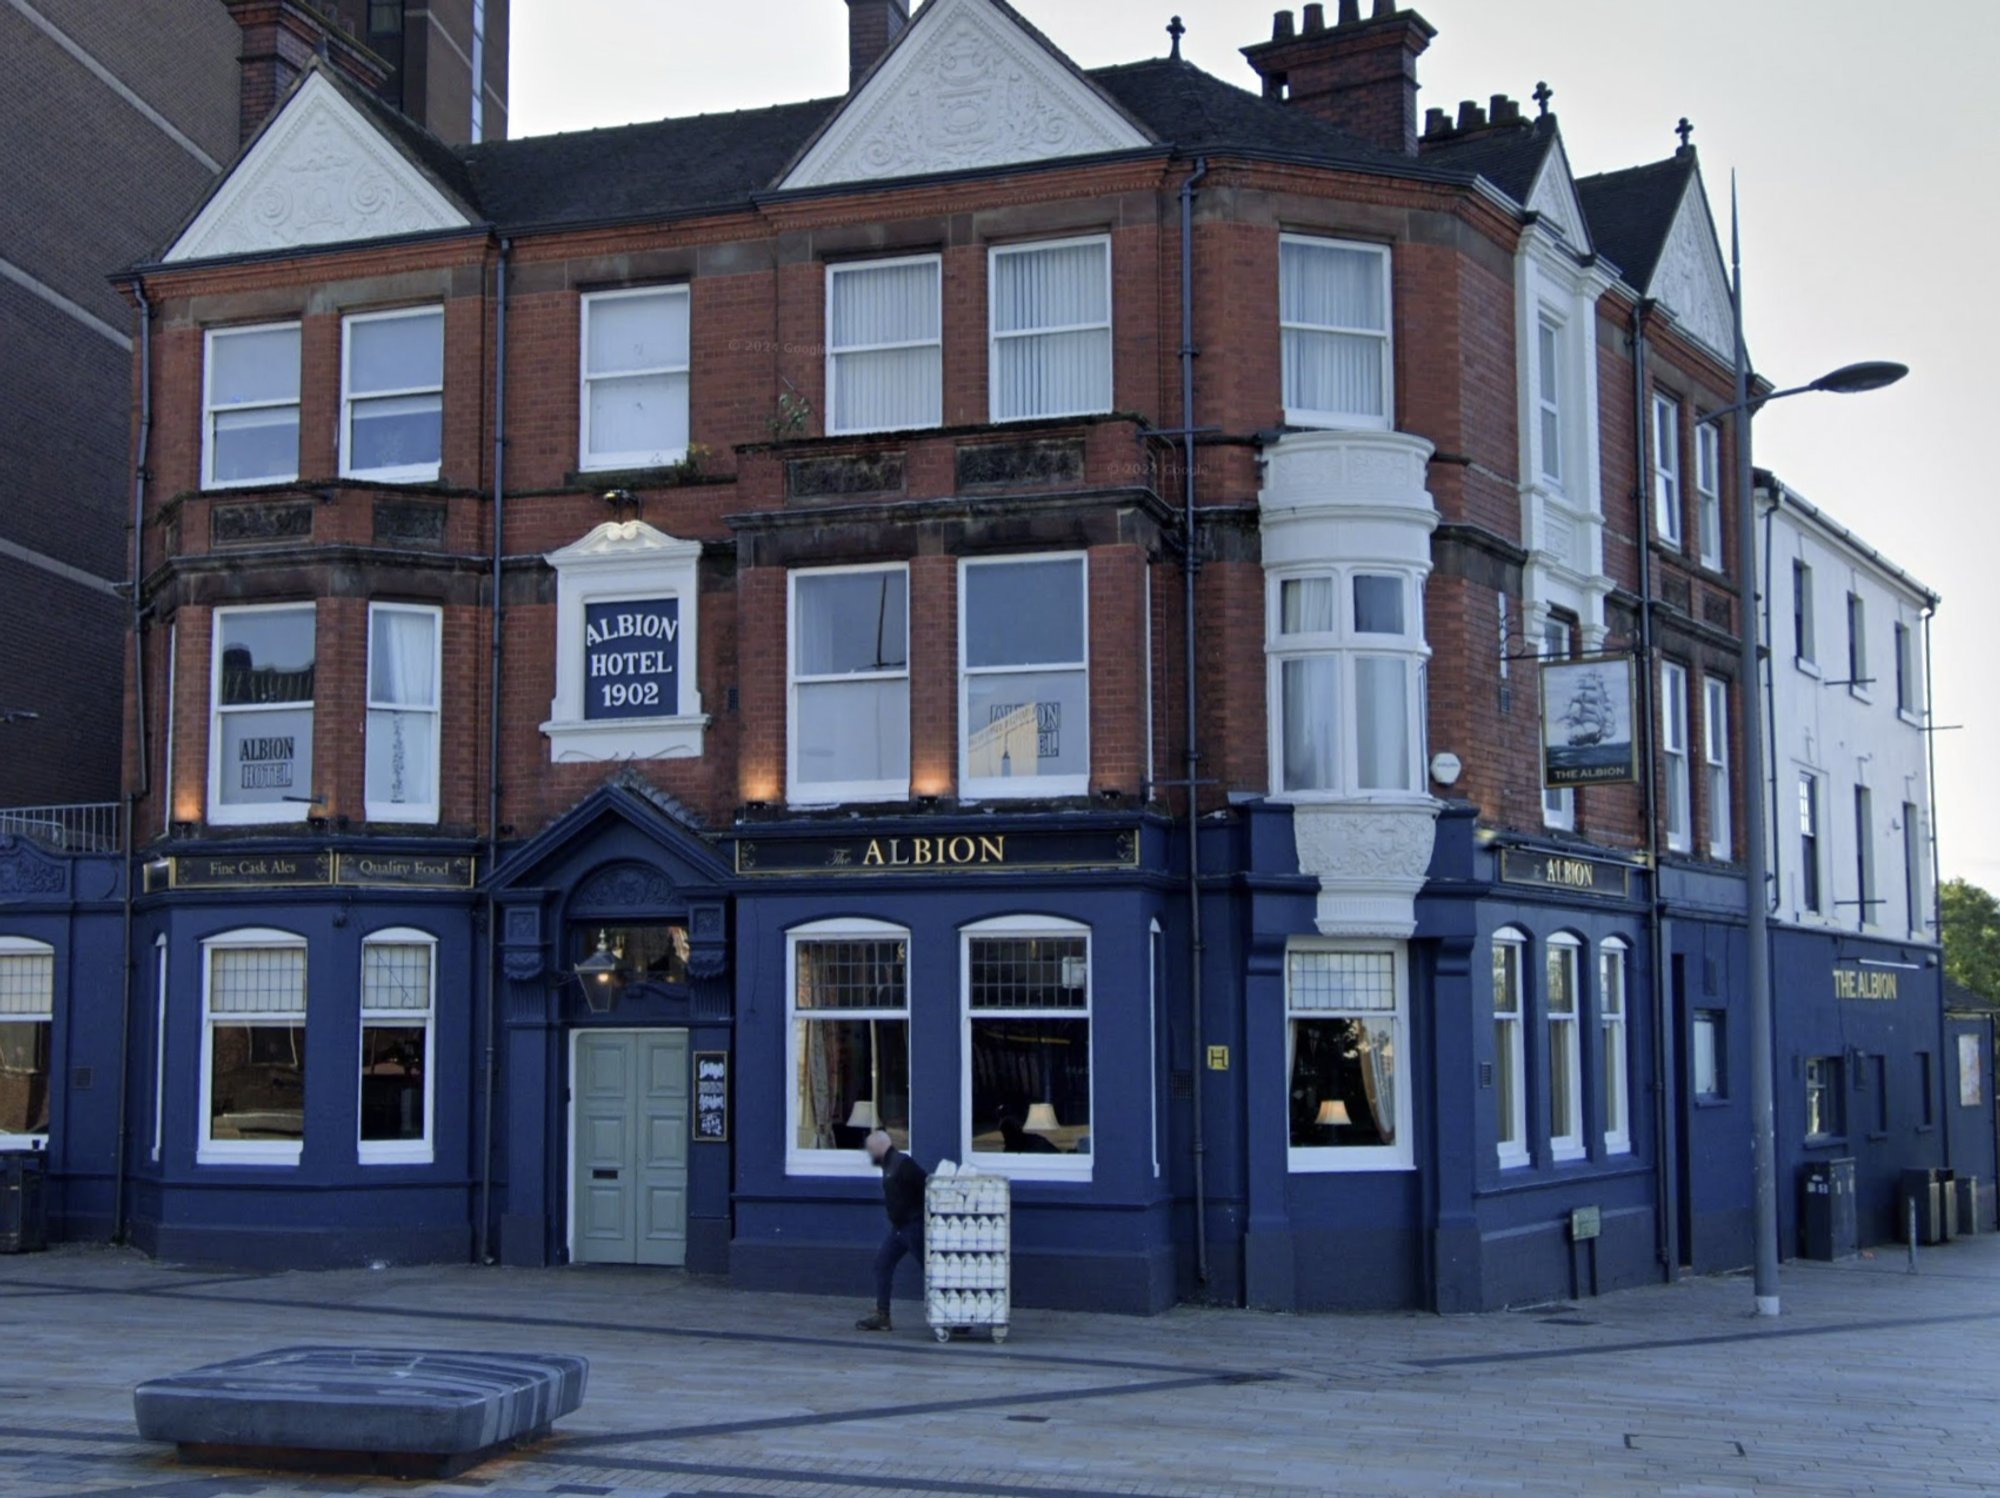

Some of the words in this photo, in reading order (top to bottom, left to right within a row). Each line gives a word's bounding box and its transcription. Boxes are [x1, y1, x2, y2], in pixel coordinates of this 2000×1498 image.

[586, 614, 678, 647] ALBION
[591, 651, 672, 677] HOTEL
[602, 682, 658, 706] 1902
[240, 737, 294, 761] ALBION
[242, 762, 293, 789] HOTEL
[1555, 770, 1577, 779] THE
[1581, 767, 1625, 778] ALBION
[862, 836, 1004, 865] ALBION
[210, 861, 236, 875] Fine
[239, 860, 267, 874] Cask
[271, 860, 297, 874] Ales
[360, 860, 410, 878] Quality
[415, 861, 449, 875] Food
[1546, 859, 1593, 886] ALBION
[1833, 970, 1856, 998] THE
[1858, 971, 1897, 999] ALBION
[1210, 1049, 1225, 1067] H
